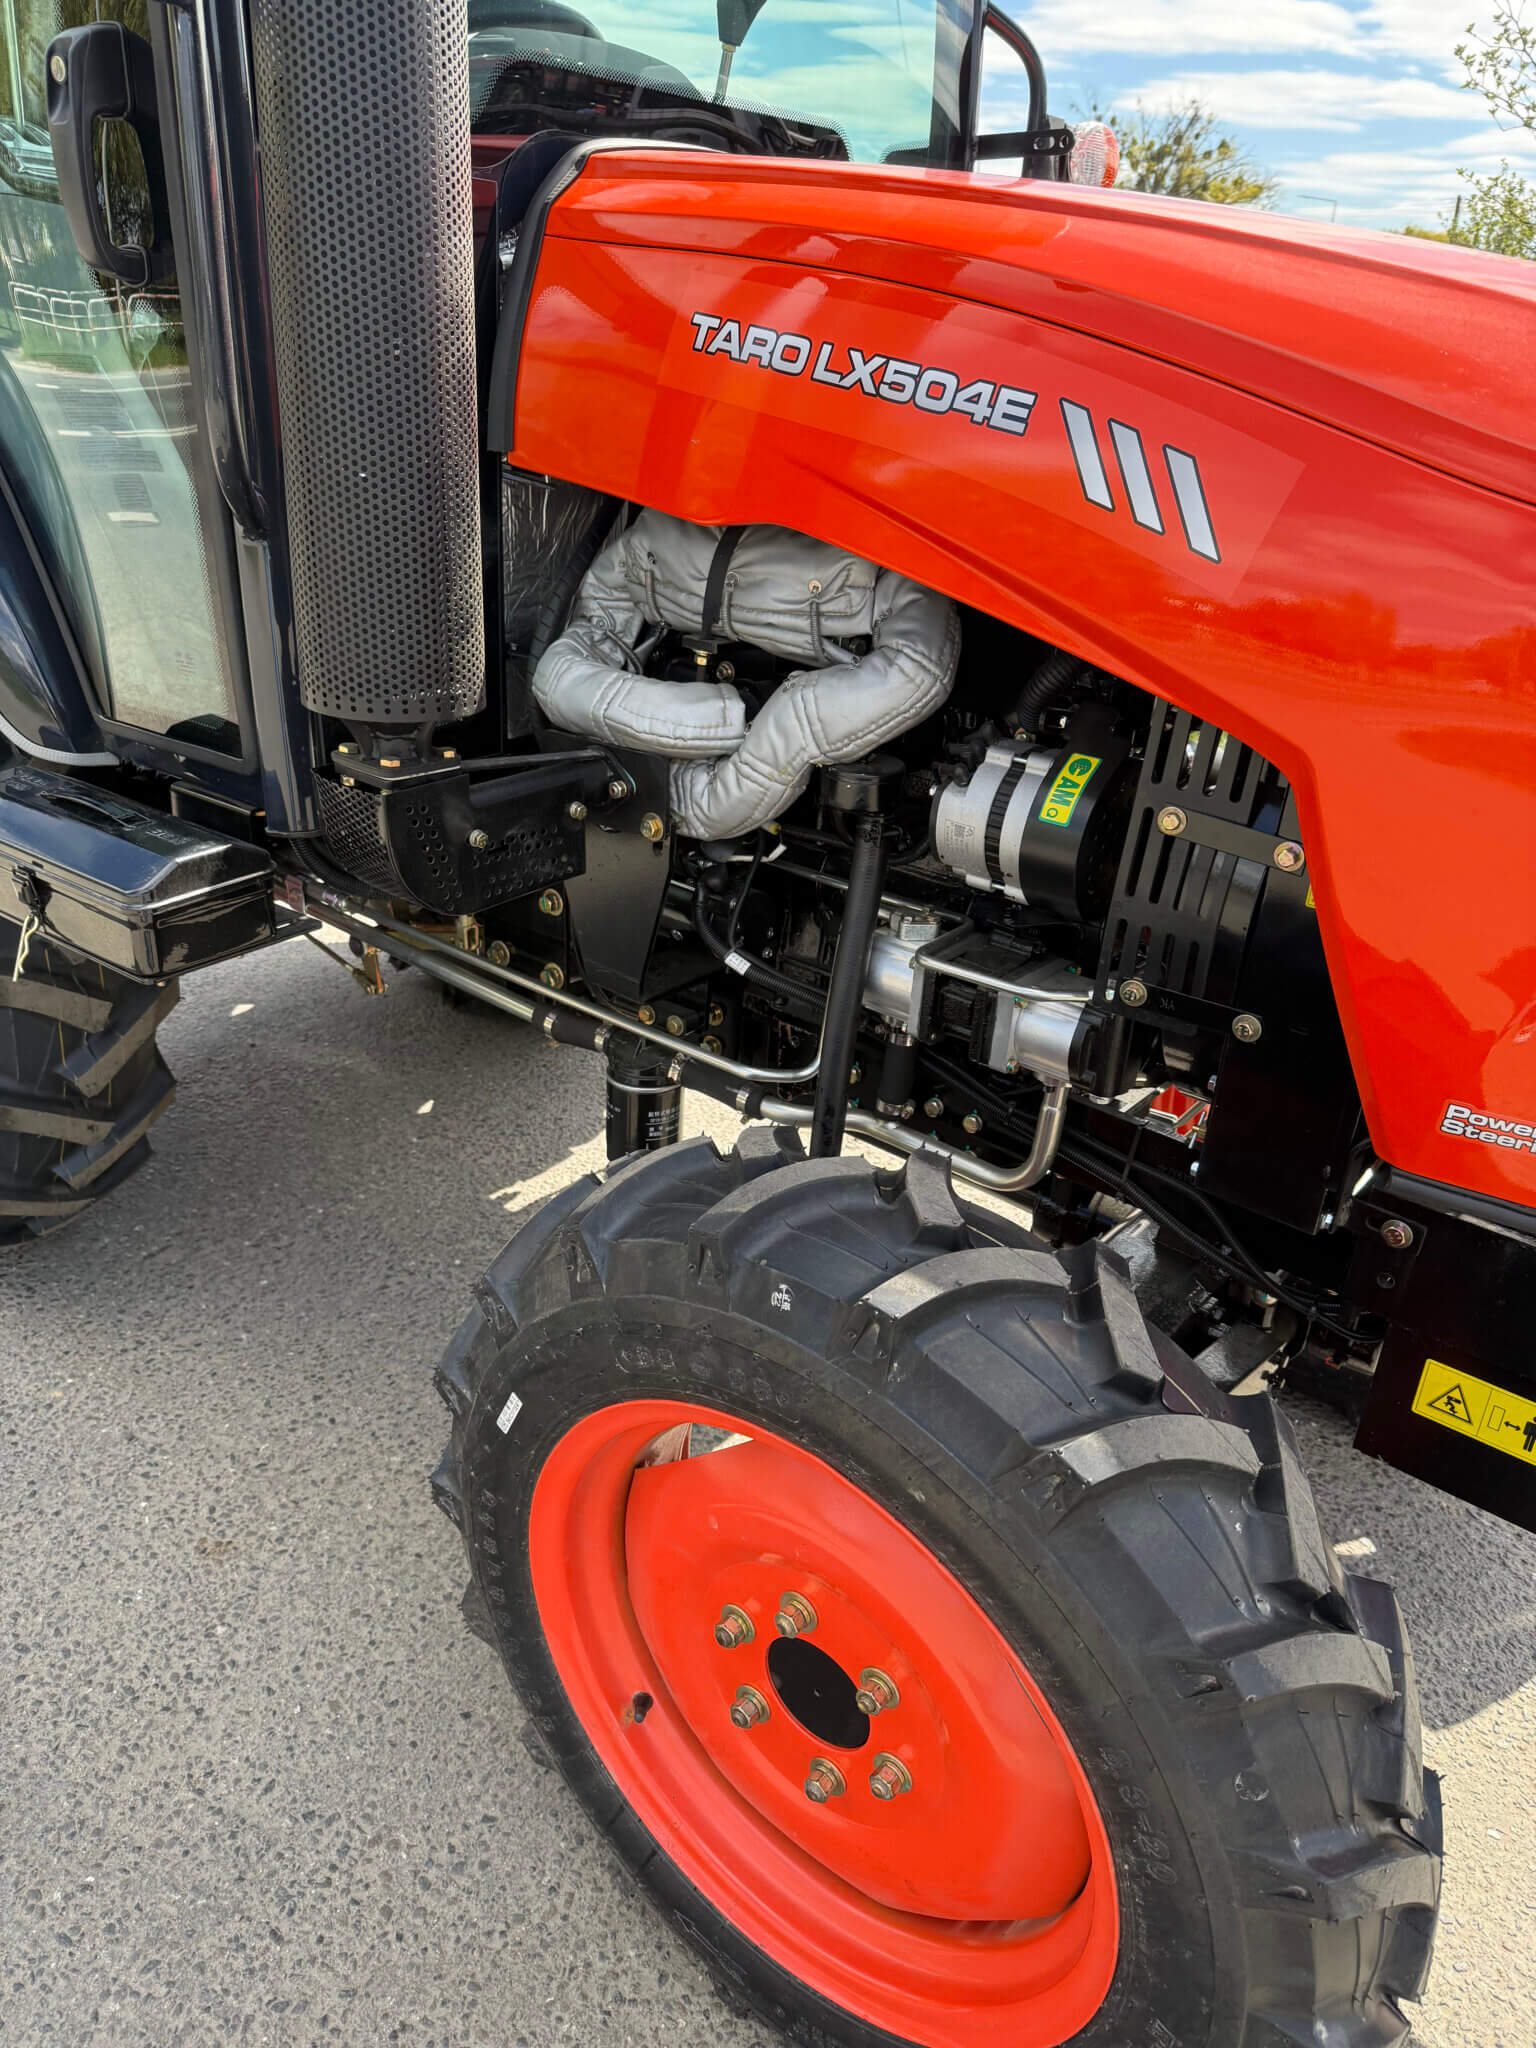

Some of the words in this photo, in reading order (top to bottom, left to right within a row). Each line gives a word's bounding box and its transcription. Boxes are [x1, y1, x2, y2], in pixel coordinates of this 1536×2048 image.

[691, 312, 811, 375] TARO
[812, 342, 1038, 437] LX504E
[1445, 1103, 1536, 1139] Powe
